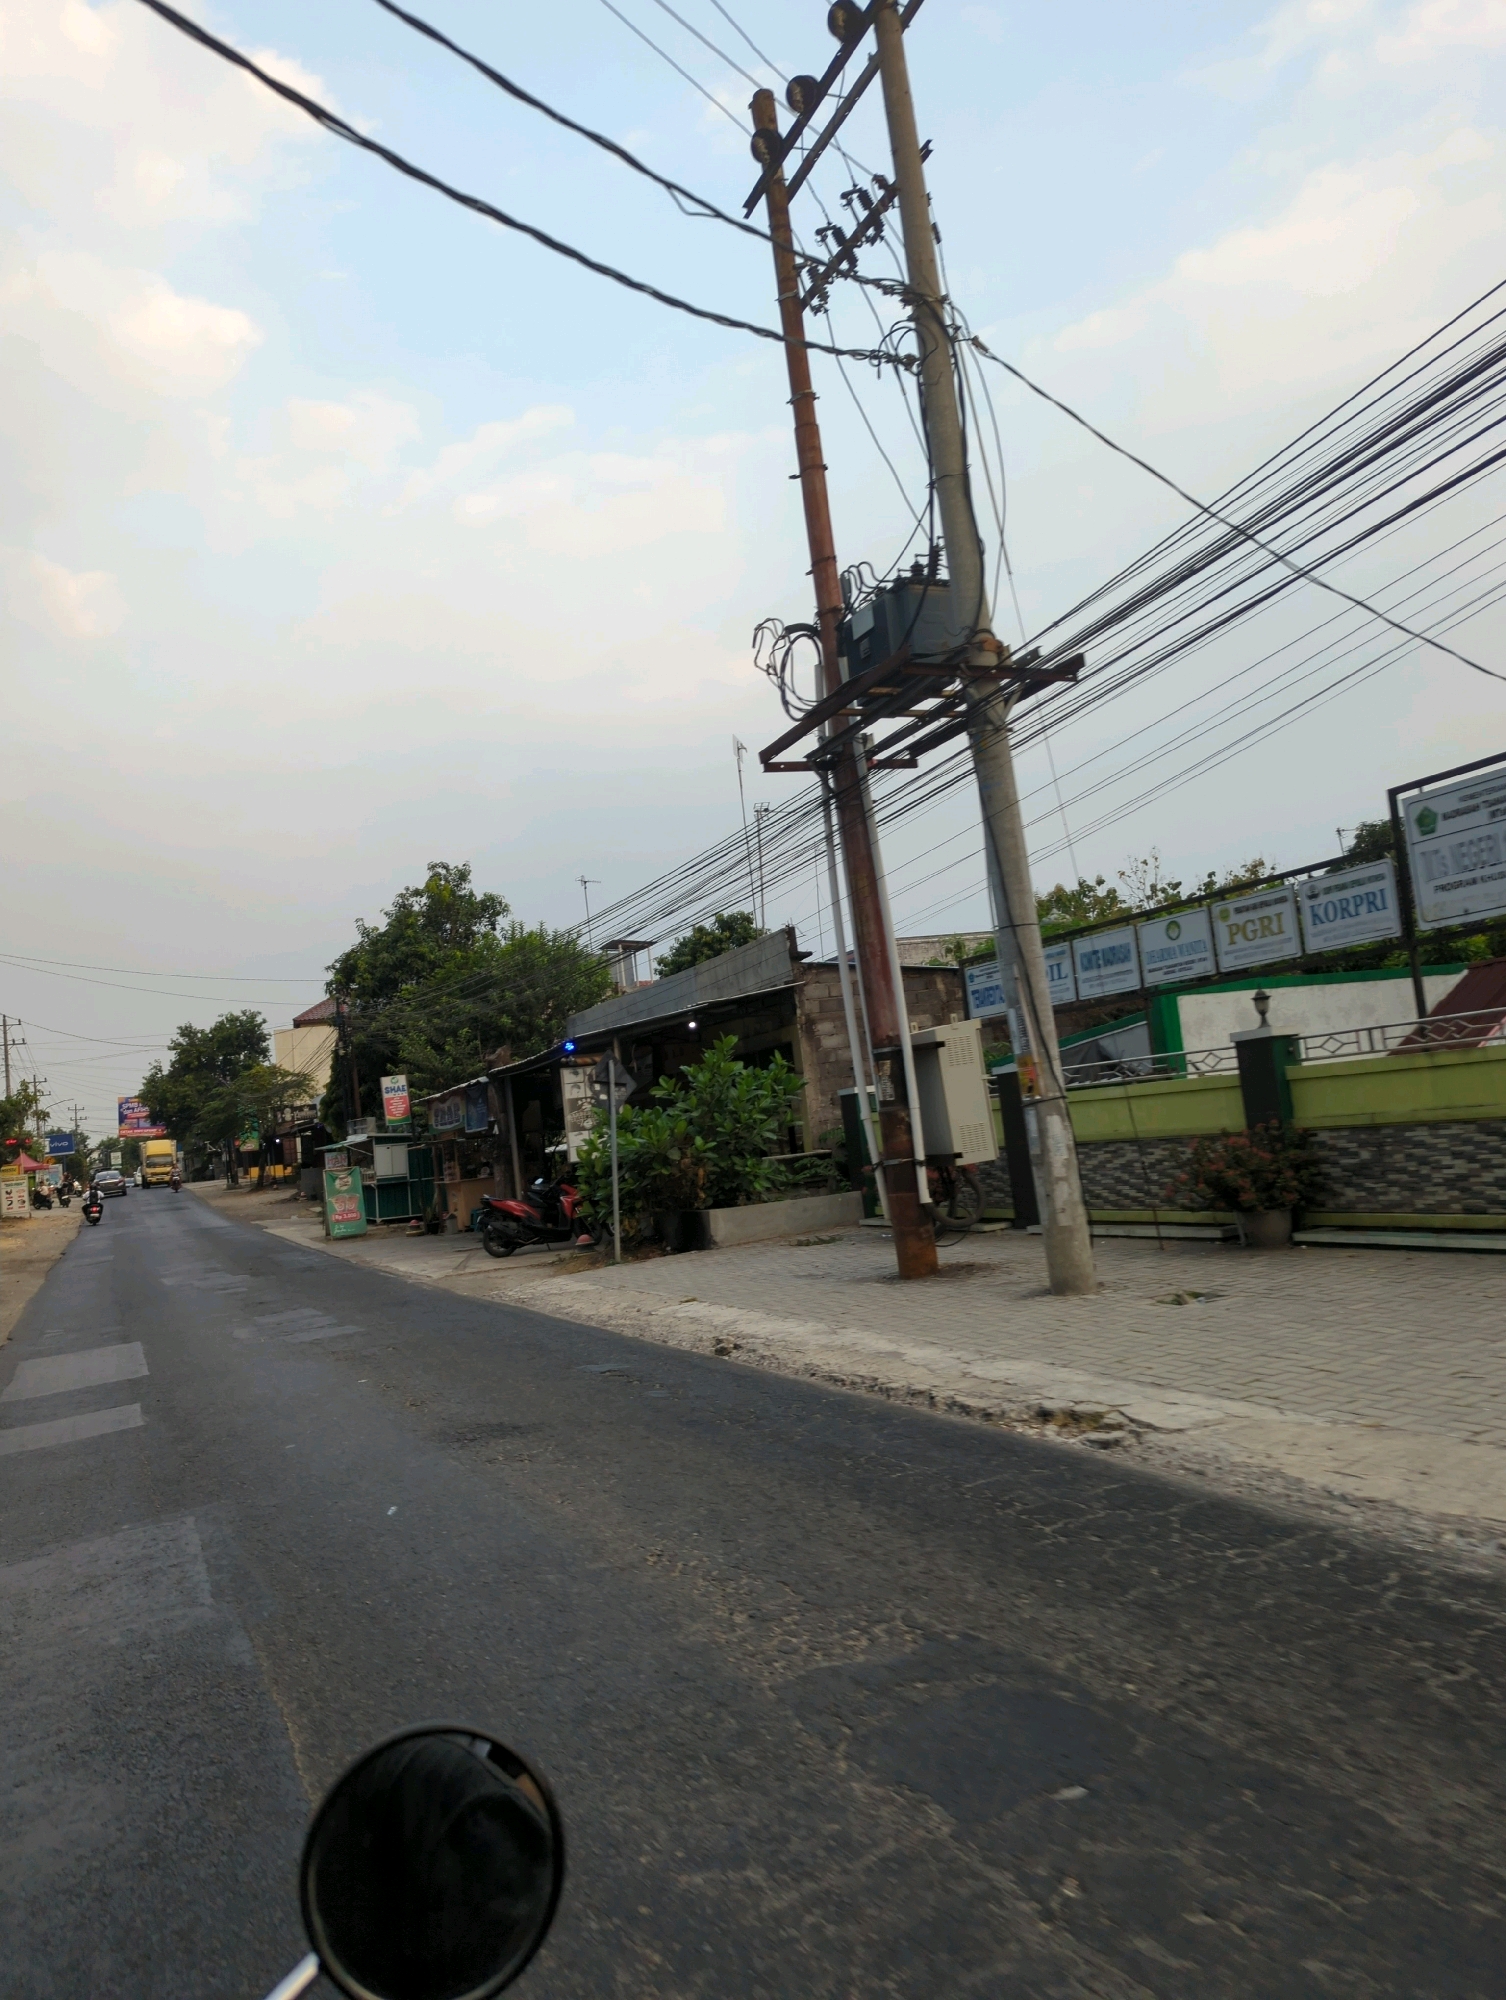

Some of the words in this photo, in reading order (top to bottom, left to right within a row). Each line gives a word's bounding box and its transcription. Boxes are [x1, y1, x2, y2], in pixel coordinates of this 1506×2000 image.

[1433, 875, 1477, 894] PROGRAM
[1309, 888, 1388, 926] KORPRI
[1225, 911, 1285, 946] PGRI
